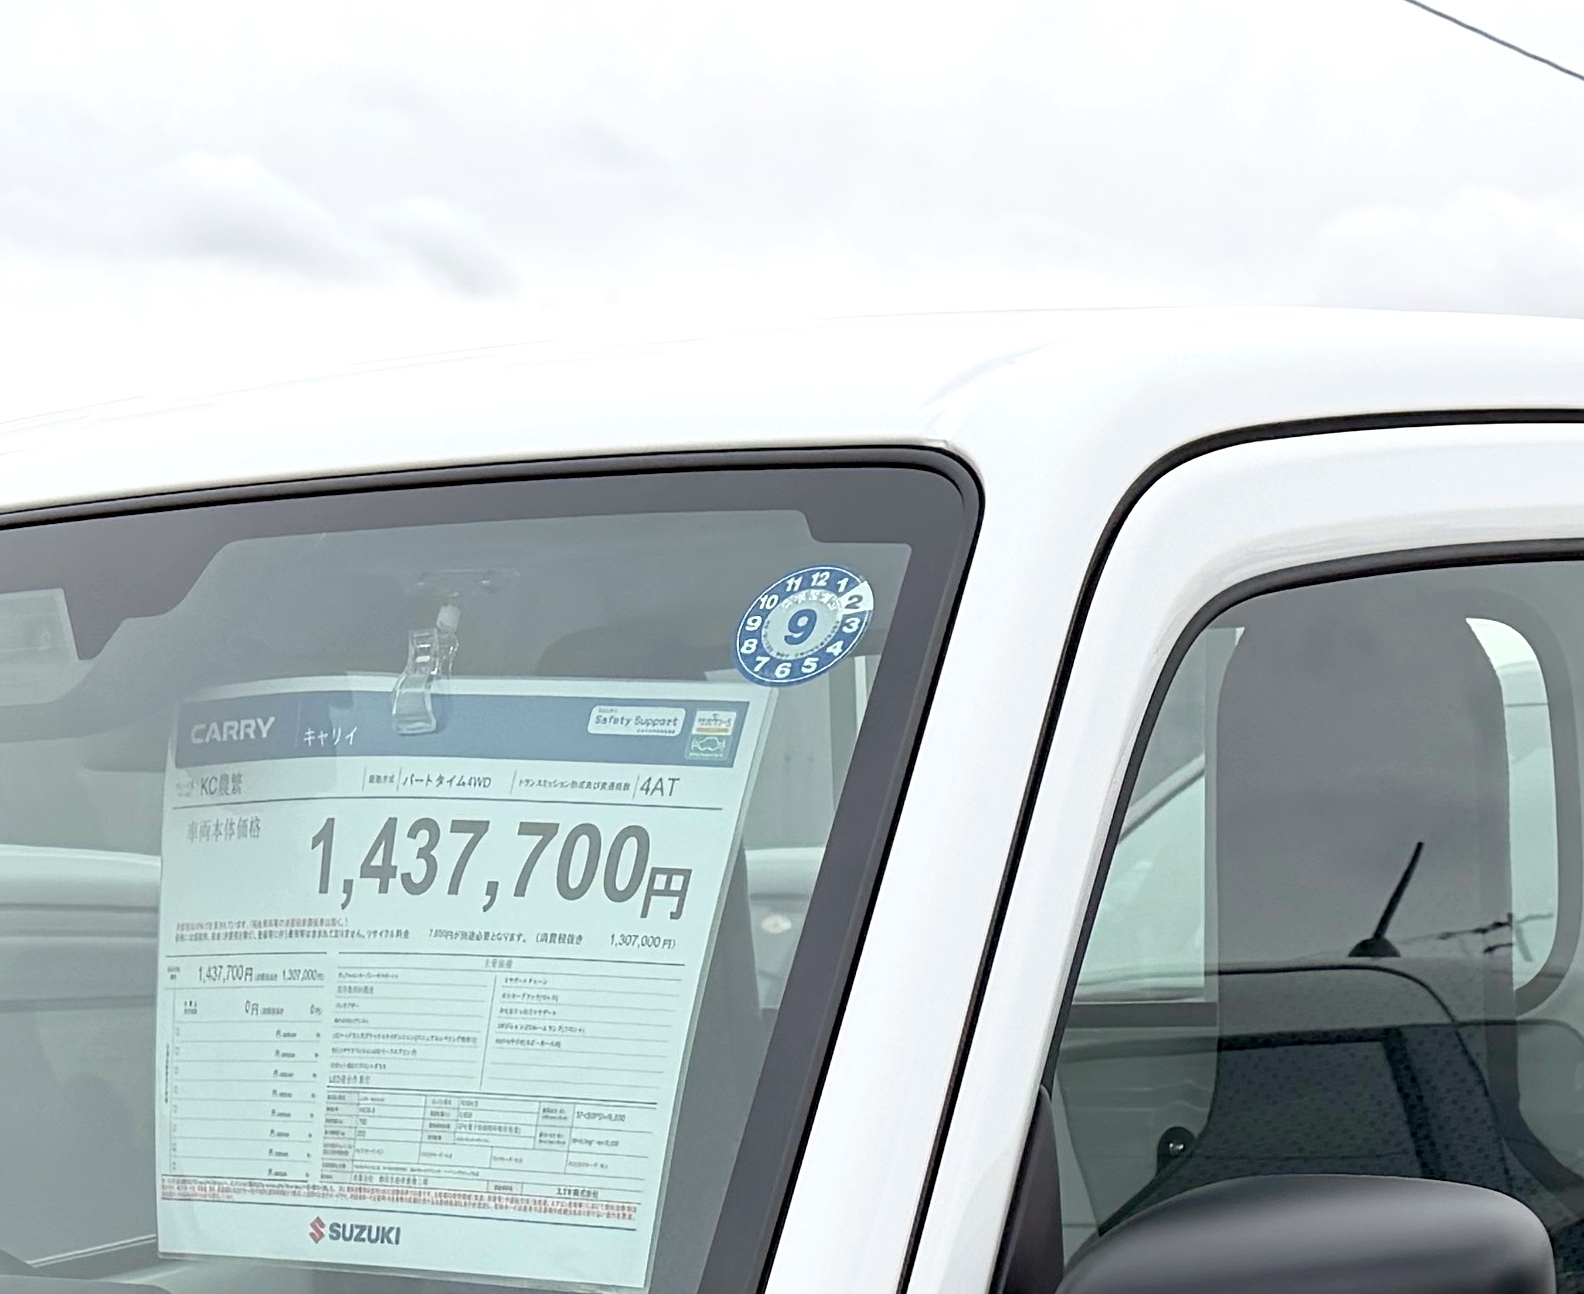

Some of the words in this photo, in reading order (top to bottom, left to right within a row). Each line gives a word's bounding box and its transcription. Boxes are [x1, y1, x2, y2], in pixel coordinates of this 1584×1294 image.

[786, 576, 803, 592] 11
[811, 571, 831, 587] 12
[837, 578, 848, 592] 1
[759, 594, 779, 610] 10
[844, 594, 864, 610] 2
[745, 616, 762, 631] 9
[784, 608, 817, 645] 9
[842, 617, 860, 633] 3
[740, 639, 758, 654] 8
[826, 641, 845, 656] 4
[753, 656, 770, 672] 7
[774, 662, 792, 678] 6
[801, 657, 819, 673] 5
[190, 716, 275, 744] CARRY
[303, 727, 358, 747] キャリイ
[639, 777, 681, 797] 4AT
[328, 1221, 402, 1245] SUZUKI
